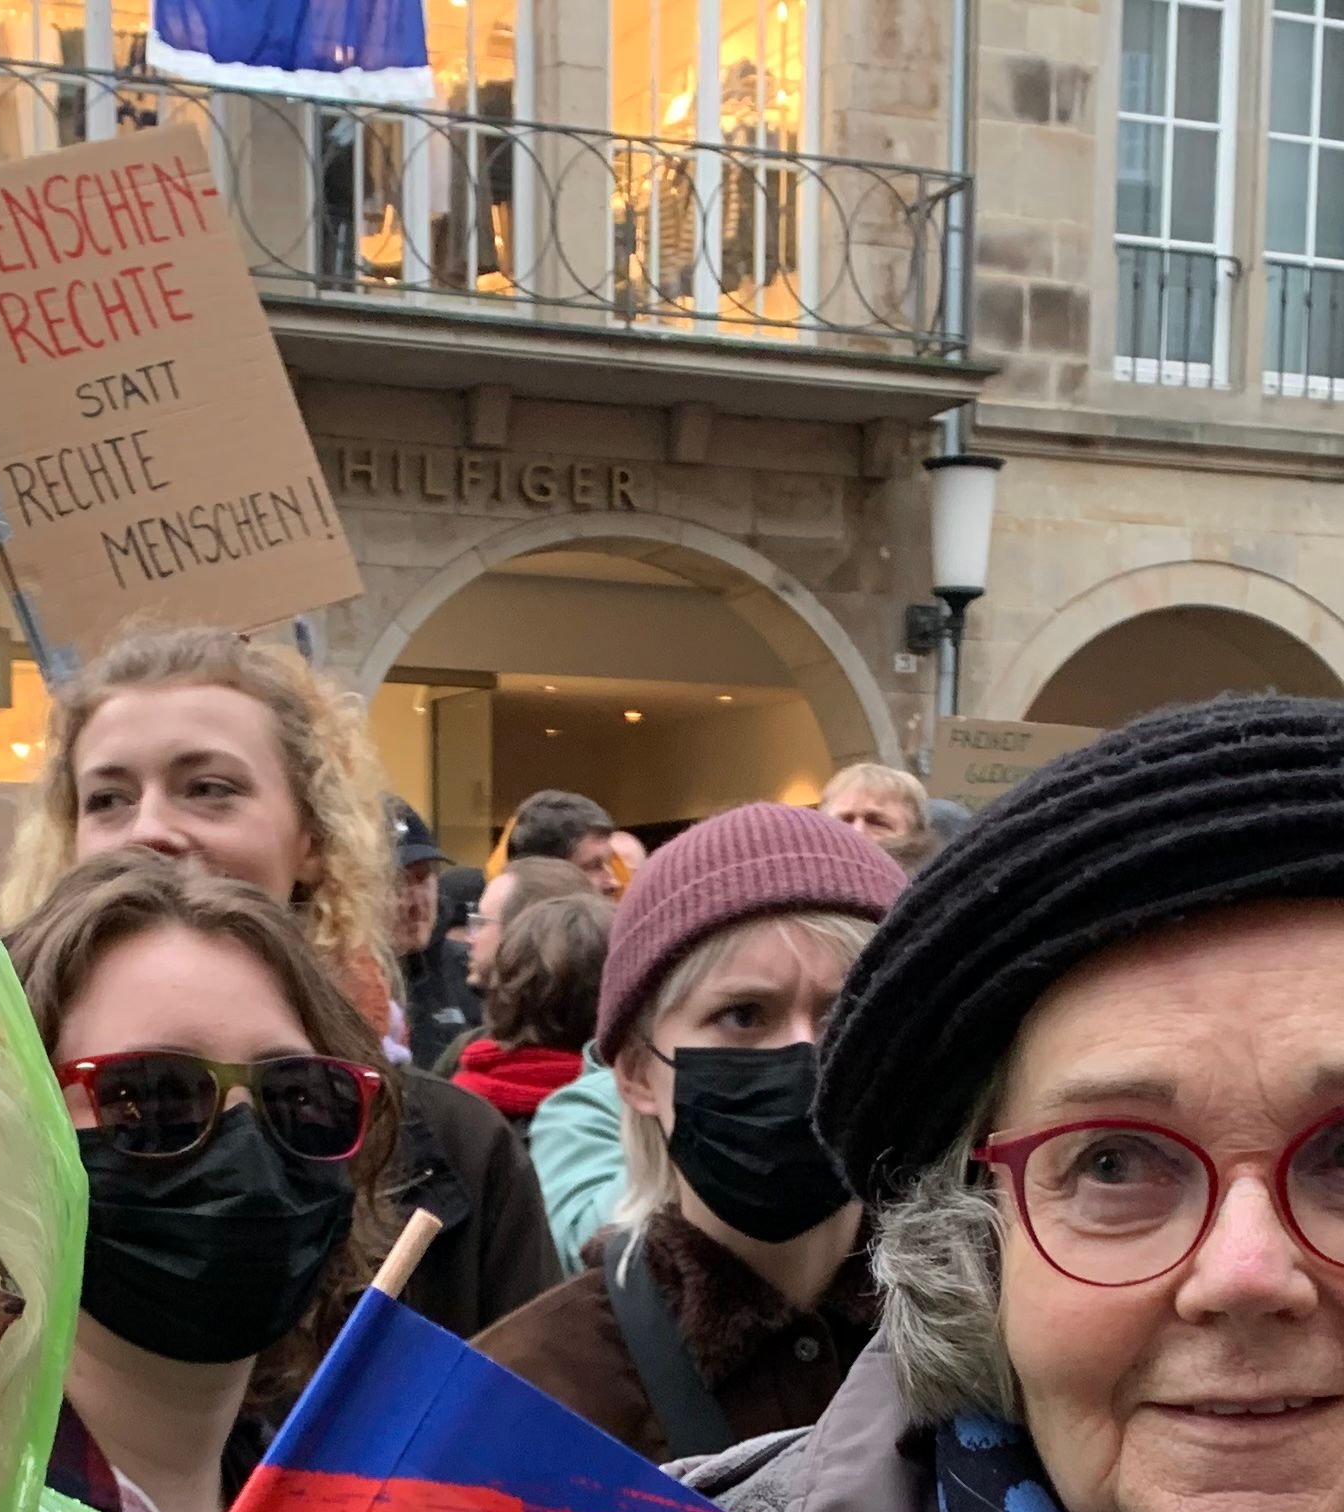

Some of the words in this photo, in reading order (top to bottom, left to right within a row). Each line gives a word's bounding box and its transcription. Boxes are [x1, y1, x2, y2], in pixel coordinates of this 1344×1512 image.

[75, 360, 183, 418] STATT
[3, 429, 172, 527] RECHTE
[338, 448, 638, 512] HILFIGER
[100, 477, 336, 589] MENSCHEN!
